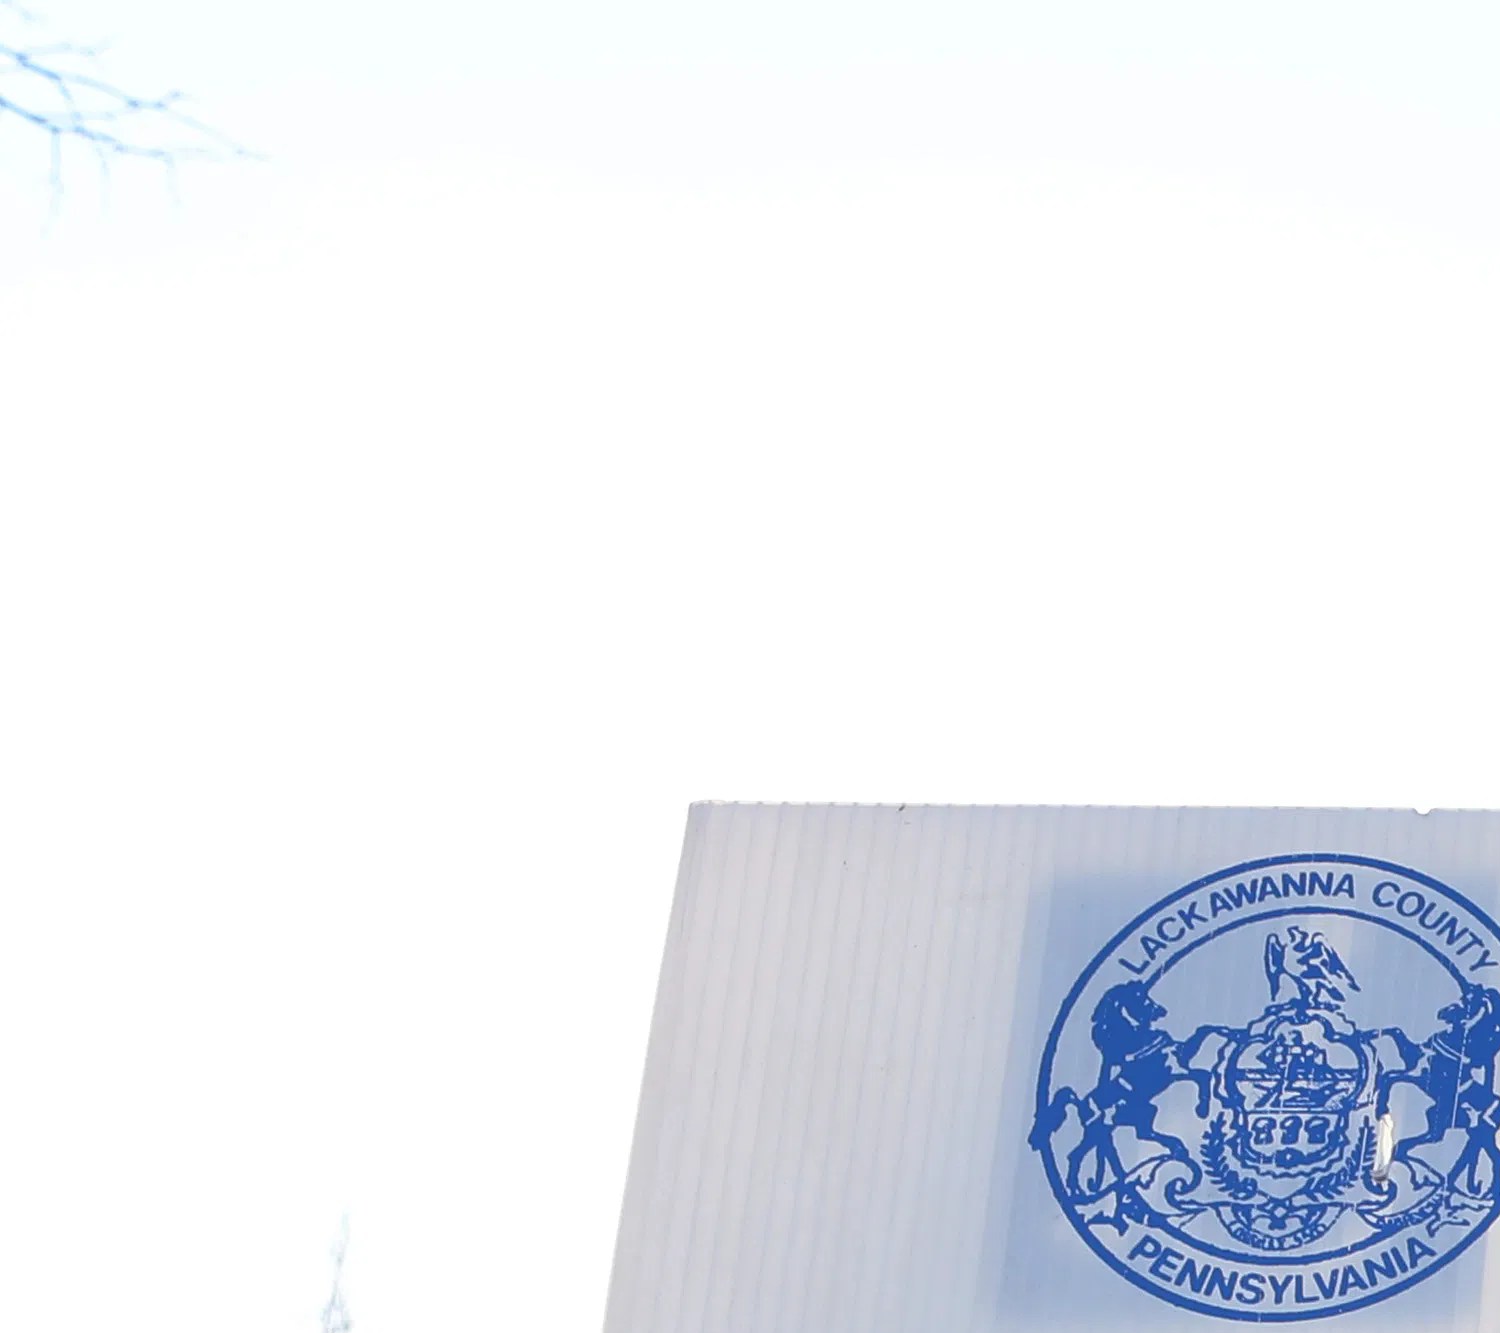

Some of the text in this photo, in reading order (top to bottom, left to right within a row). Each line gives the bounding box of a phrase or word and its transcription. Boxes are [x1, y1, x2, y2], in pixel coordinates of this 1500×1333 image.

[1118, 871, 1498, 975] LACKAWANNA COUNTY
[1128, 1232, 1437, 1305] PENNSYLVANIA
